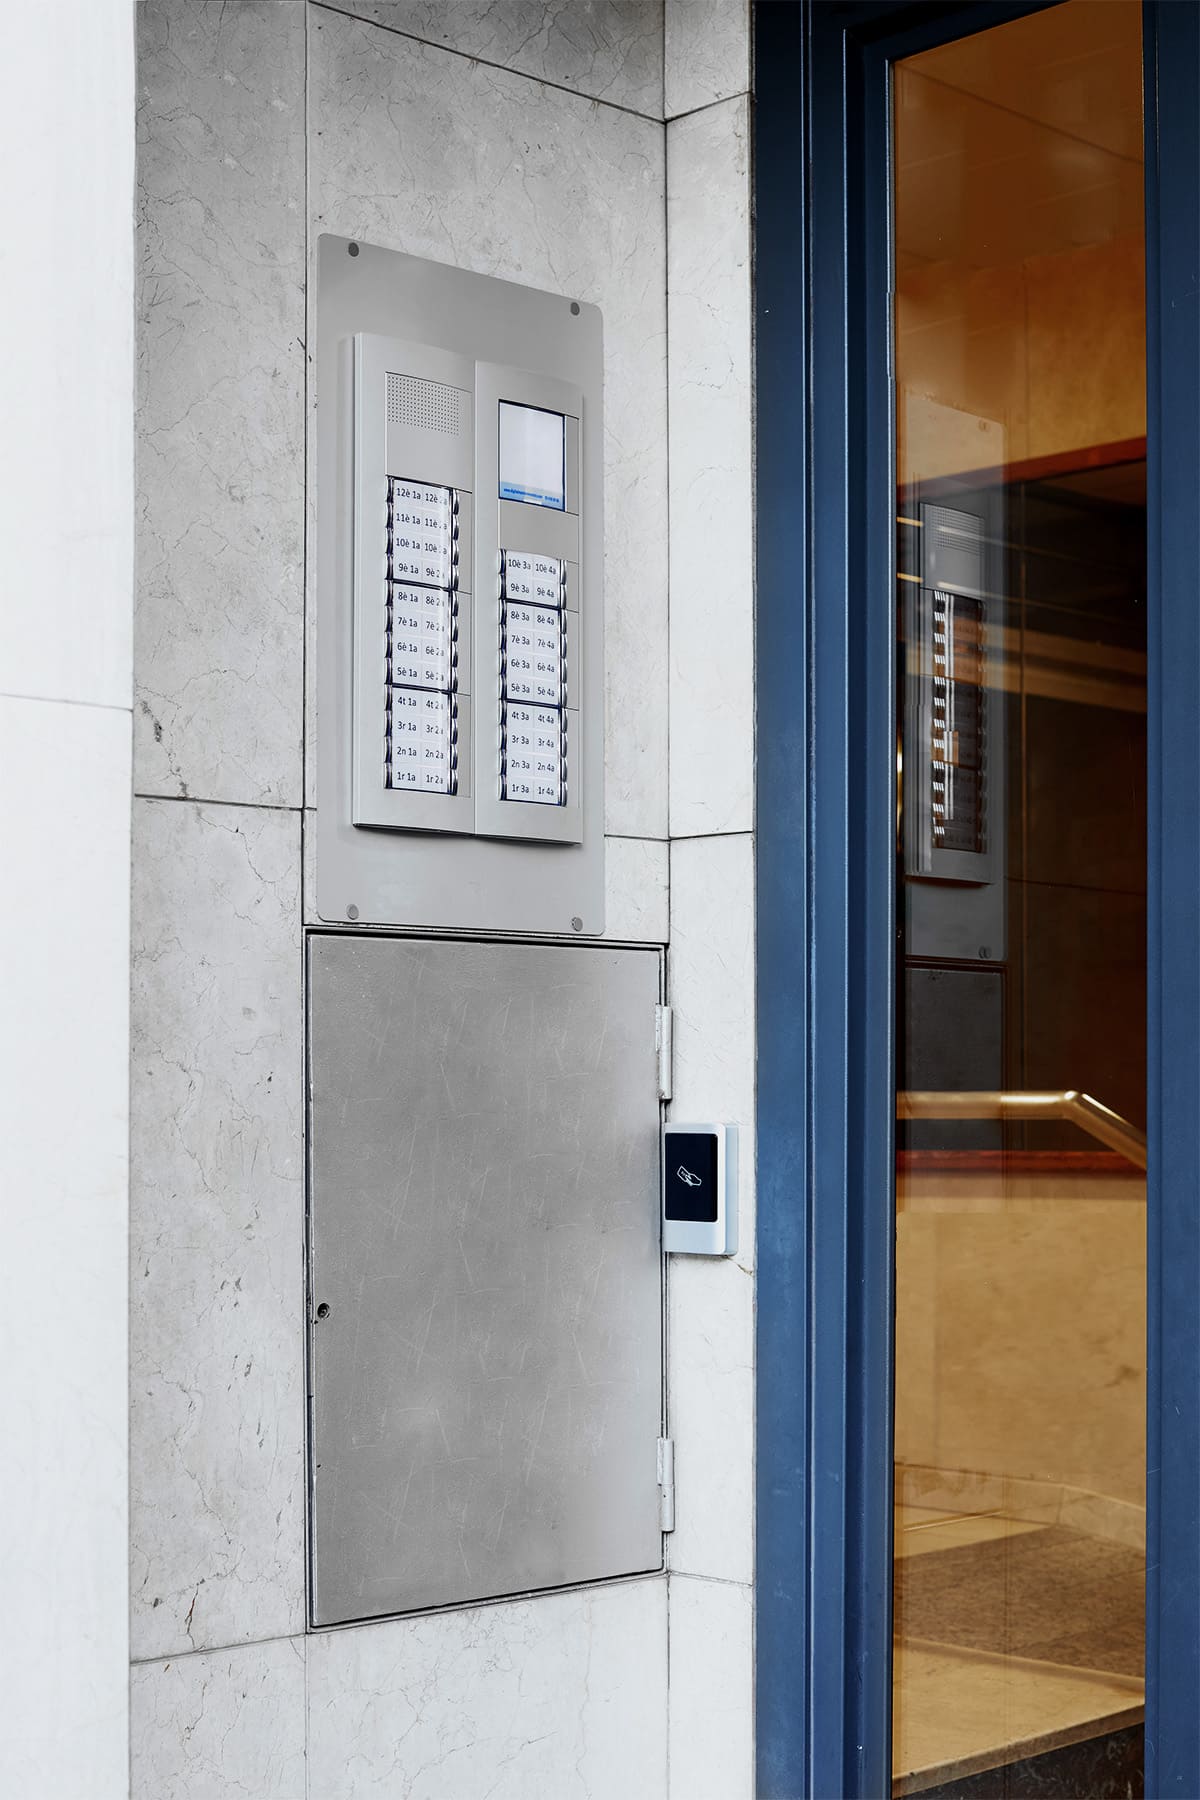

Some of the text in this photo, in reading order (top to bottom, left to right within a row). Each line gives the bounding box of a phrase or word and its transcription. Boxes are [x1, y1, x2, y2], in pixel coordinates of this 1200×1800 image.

[413, 491, 421, 500] 1a
[412, 516, 420, 524] 1a
[412, 541, 420, 549] 1a
[410, 566, 419, 574] 1a
[523, 561, 531, 570] 3a
[549, 566, 556, 574] 4a
[522, 585, 529, 593] 3a
[547, 589, 554, 597] 4a
[410, 594, 418, 603] 1a
[522, 613, 529, 621] 3a
[547, 616, 554, 625] 4a
[410, 619, 418, 628] 1a
[522, 637, 529, 645] 3a
[547, 640, 554, 649] 4a
[409, 644, 417, 652] 1a
[522, 660, 530, 669] 3a
[547, 664, 554, 672] 4a
[409, 669, 417, 678] 1a
[522, 685, 530, 693] 3a
[547, 688, 554, 696] 4a
[398, 697, 416, 706] 4t 1a
[426, 700, 433, 709] 4t
[521, 712, 529, 720] 3a
[538, 715, 554, 724] 4t 4a
[398, 721, 406, 730] 3r
[512, 735, 519, 743] 3r
[546, 739, 554, 748] 4a
[397, 747, 406, 755] 2n
[426, 750, 444, 759] 2n 2a
[512, 760, 529, 769] 2n 3a
[547, 764, 554, 772] 4a
[398, 772, 416, 782] 1r 1a
[426, 775, 443, 784] 1r 2a
